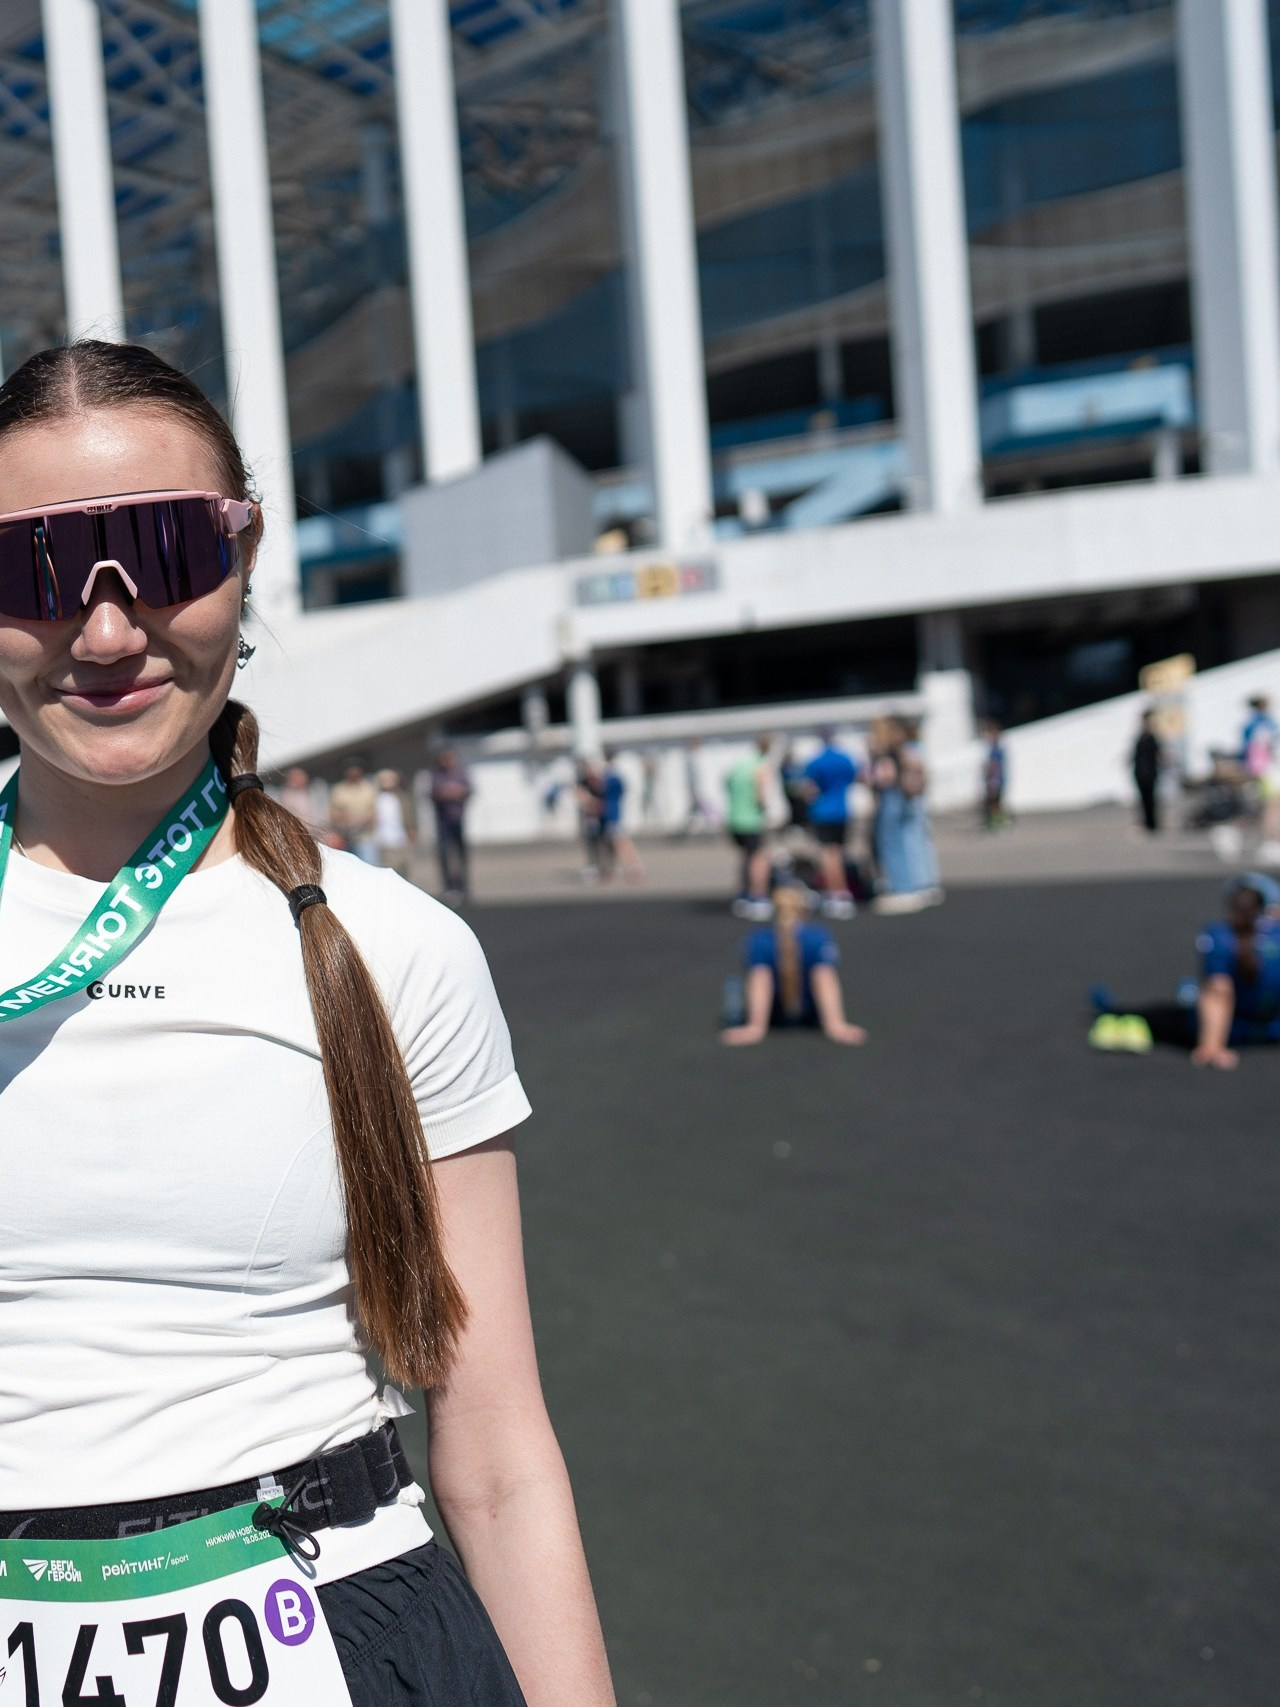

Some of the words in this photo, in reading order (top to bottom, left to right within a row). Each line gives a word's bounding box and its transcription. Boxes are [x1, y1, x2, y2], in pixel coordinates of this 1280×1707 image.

[134, 800, 205, 890] ЭТОТ
[205, 1529, 237, 1547] НИЖНИЙ
[7, 1598, 270, 1707] 1470
